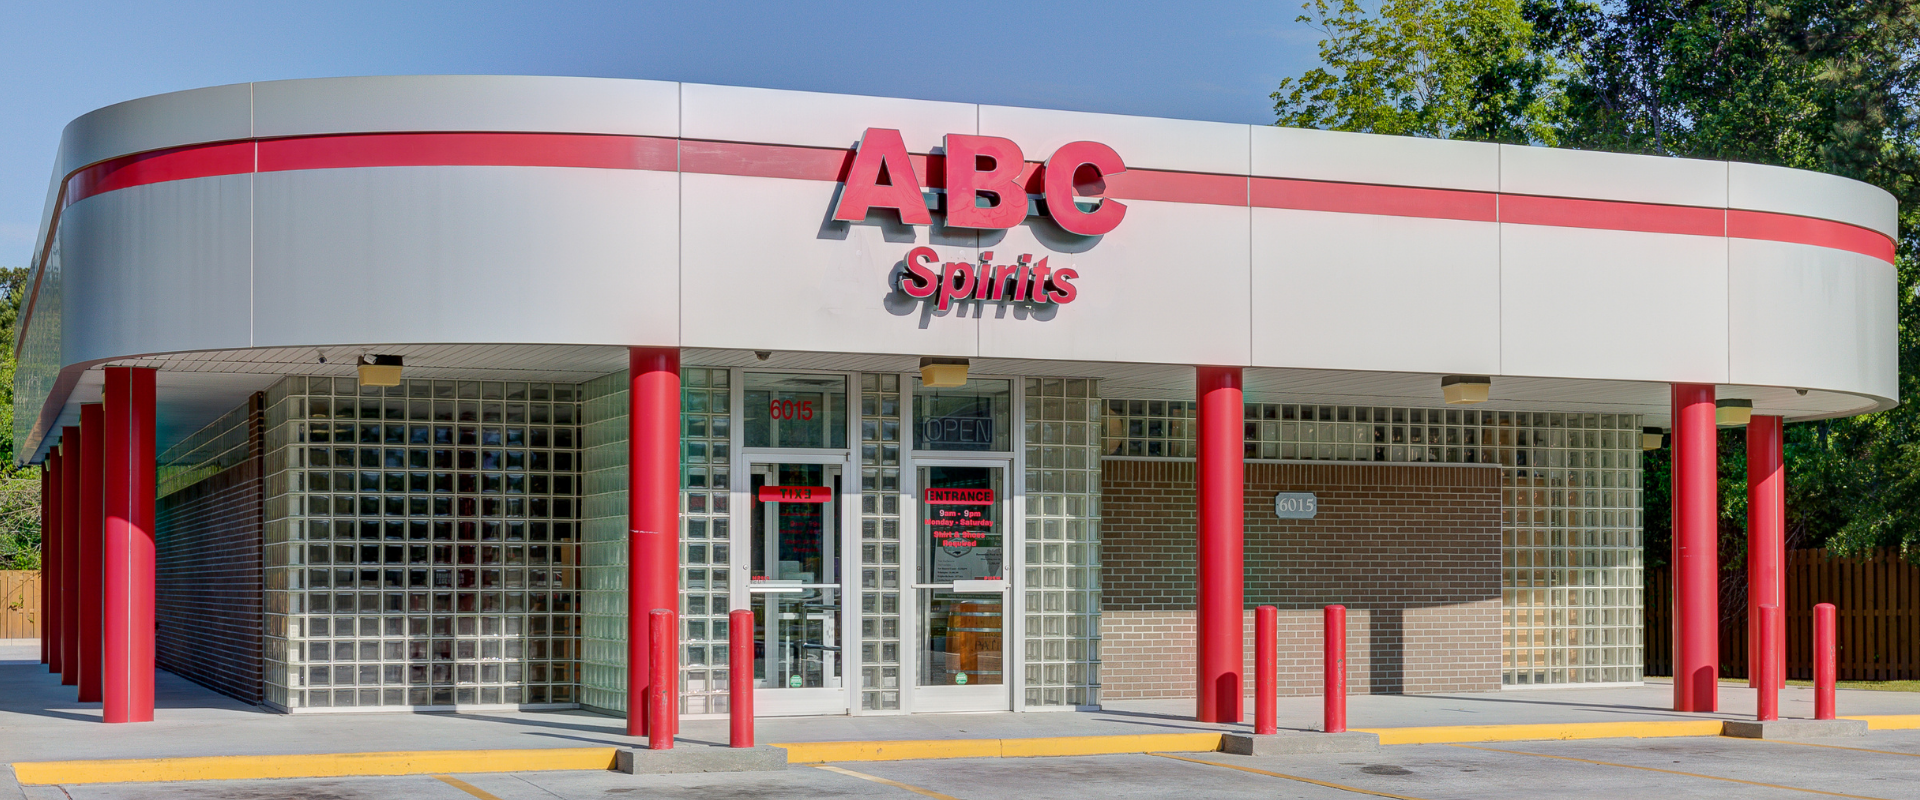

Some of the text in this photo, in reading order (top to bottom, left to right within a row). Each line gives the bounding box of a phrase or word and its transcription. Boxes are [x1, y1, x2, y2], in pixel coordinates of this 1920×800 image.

[832, 127, 1127, 236] ABC
[900, 246, 1079, 310] Spirits
[770, 399, 813, 420] 6015
[925, 418, 991, 442] OPEN
[928, 490, 991, 502] ENTRANCE
[1279, 497, 1314, 512] 6015
[939, 509, 956, 517] 9am
[964, 509, 981, 518] 9pm
[925, 519, 954, 527] Monday
[960, 518, 994, 527] Saturday
[933, 530, 952, 538] Shirt
[942, 539, 977, 548] Required
